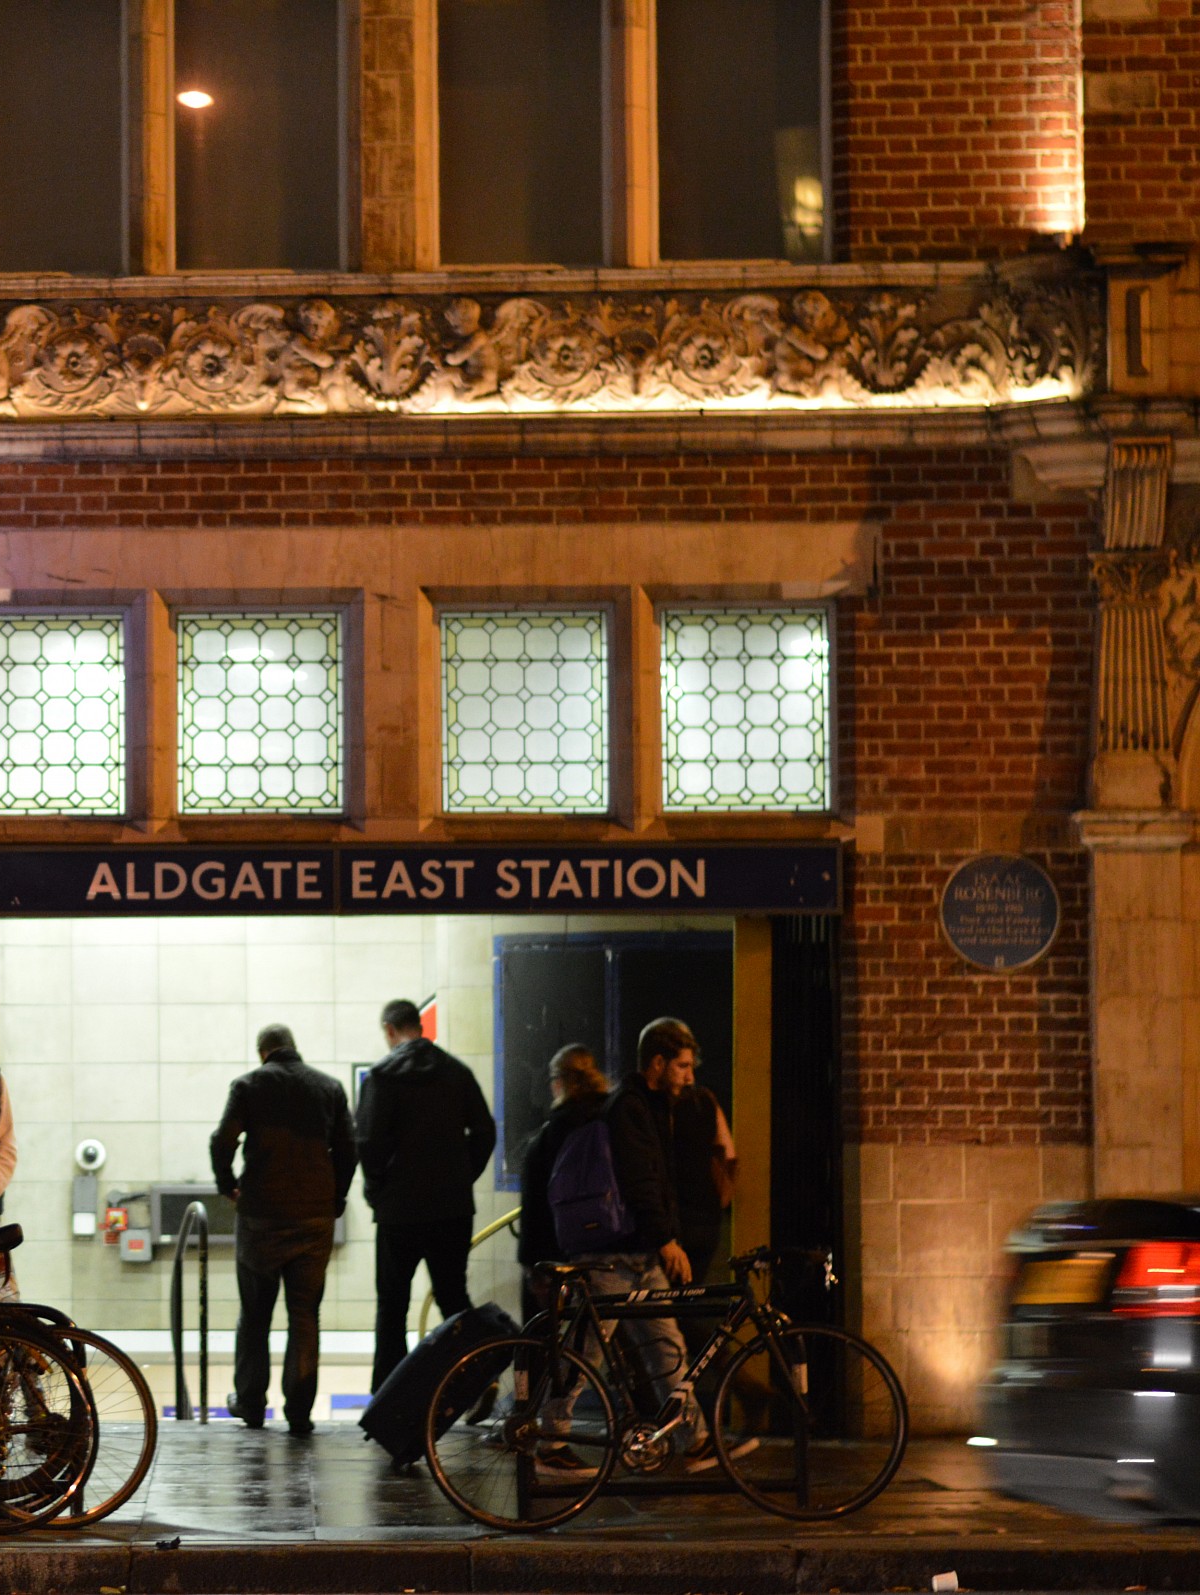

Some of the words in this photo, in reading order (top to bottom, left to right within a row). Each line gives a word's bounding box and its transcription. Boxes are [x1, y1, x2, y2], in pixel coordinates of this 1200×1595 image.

[86, 861, 322, 900] ALDGATE
[351, 860, 475, 899] EAST
[495, 859, 705, 898] STATION
